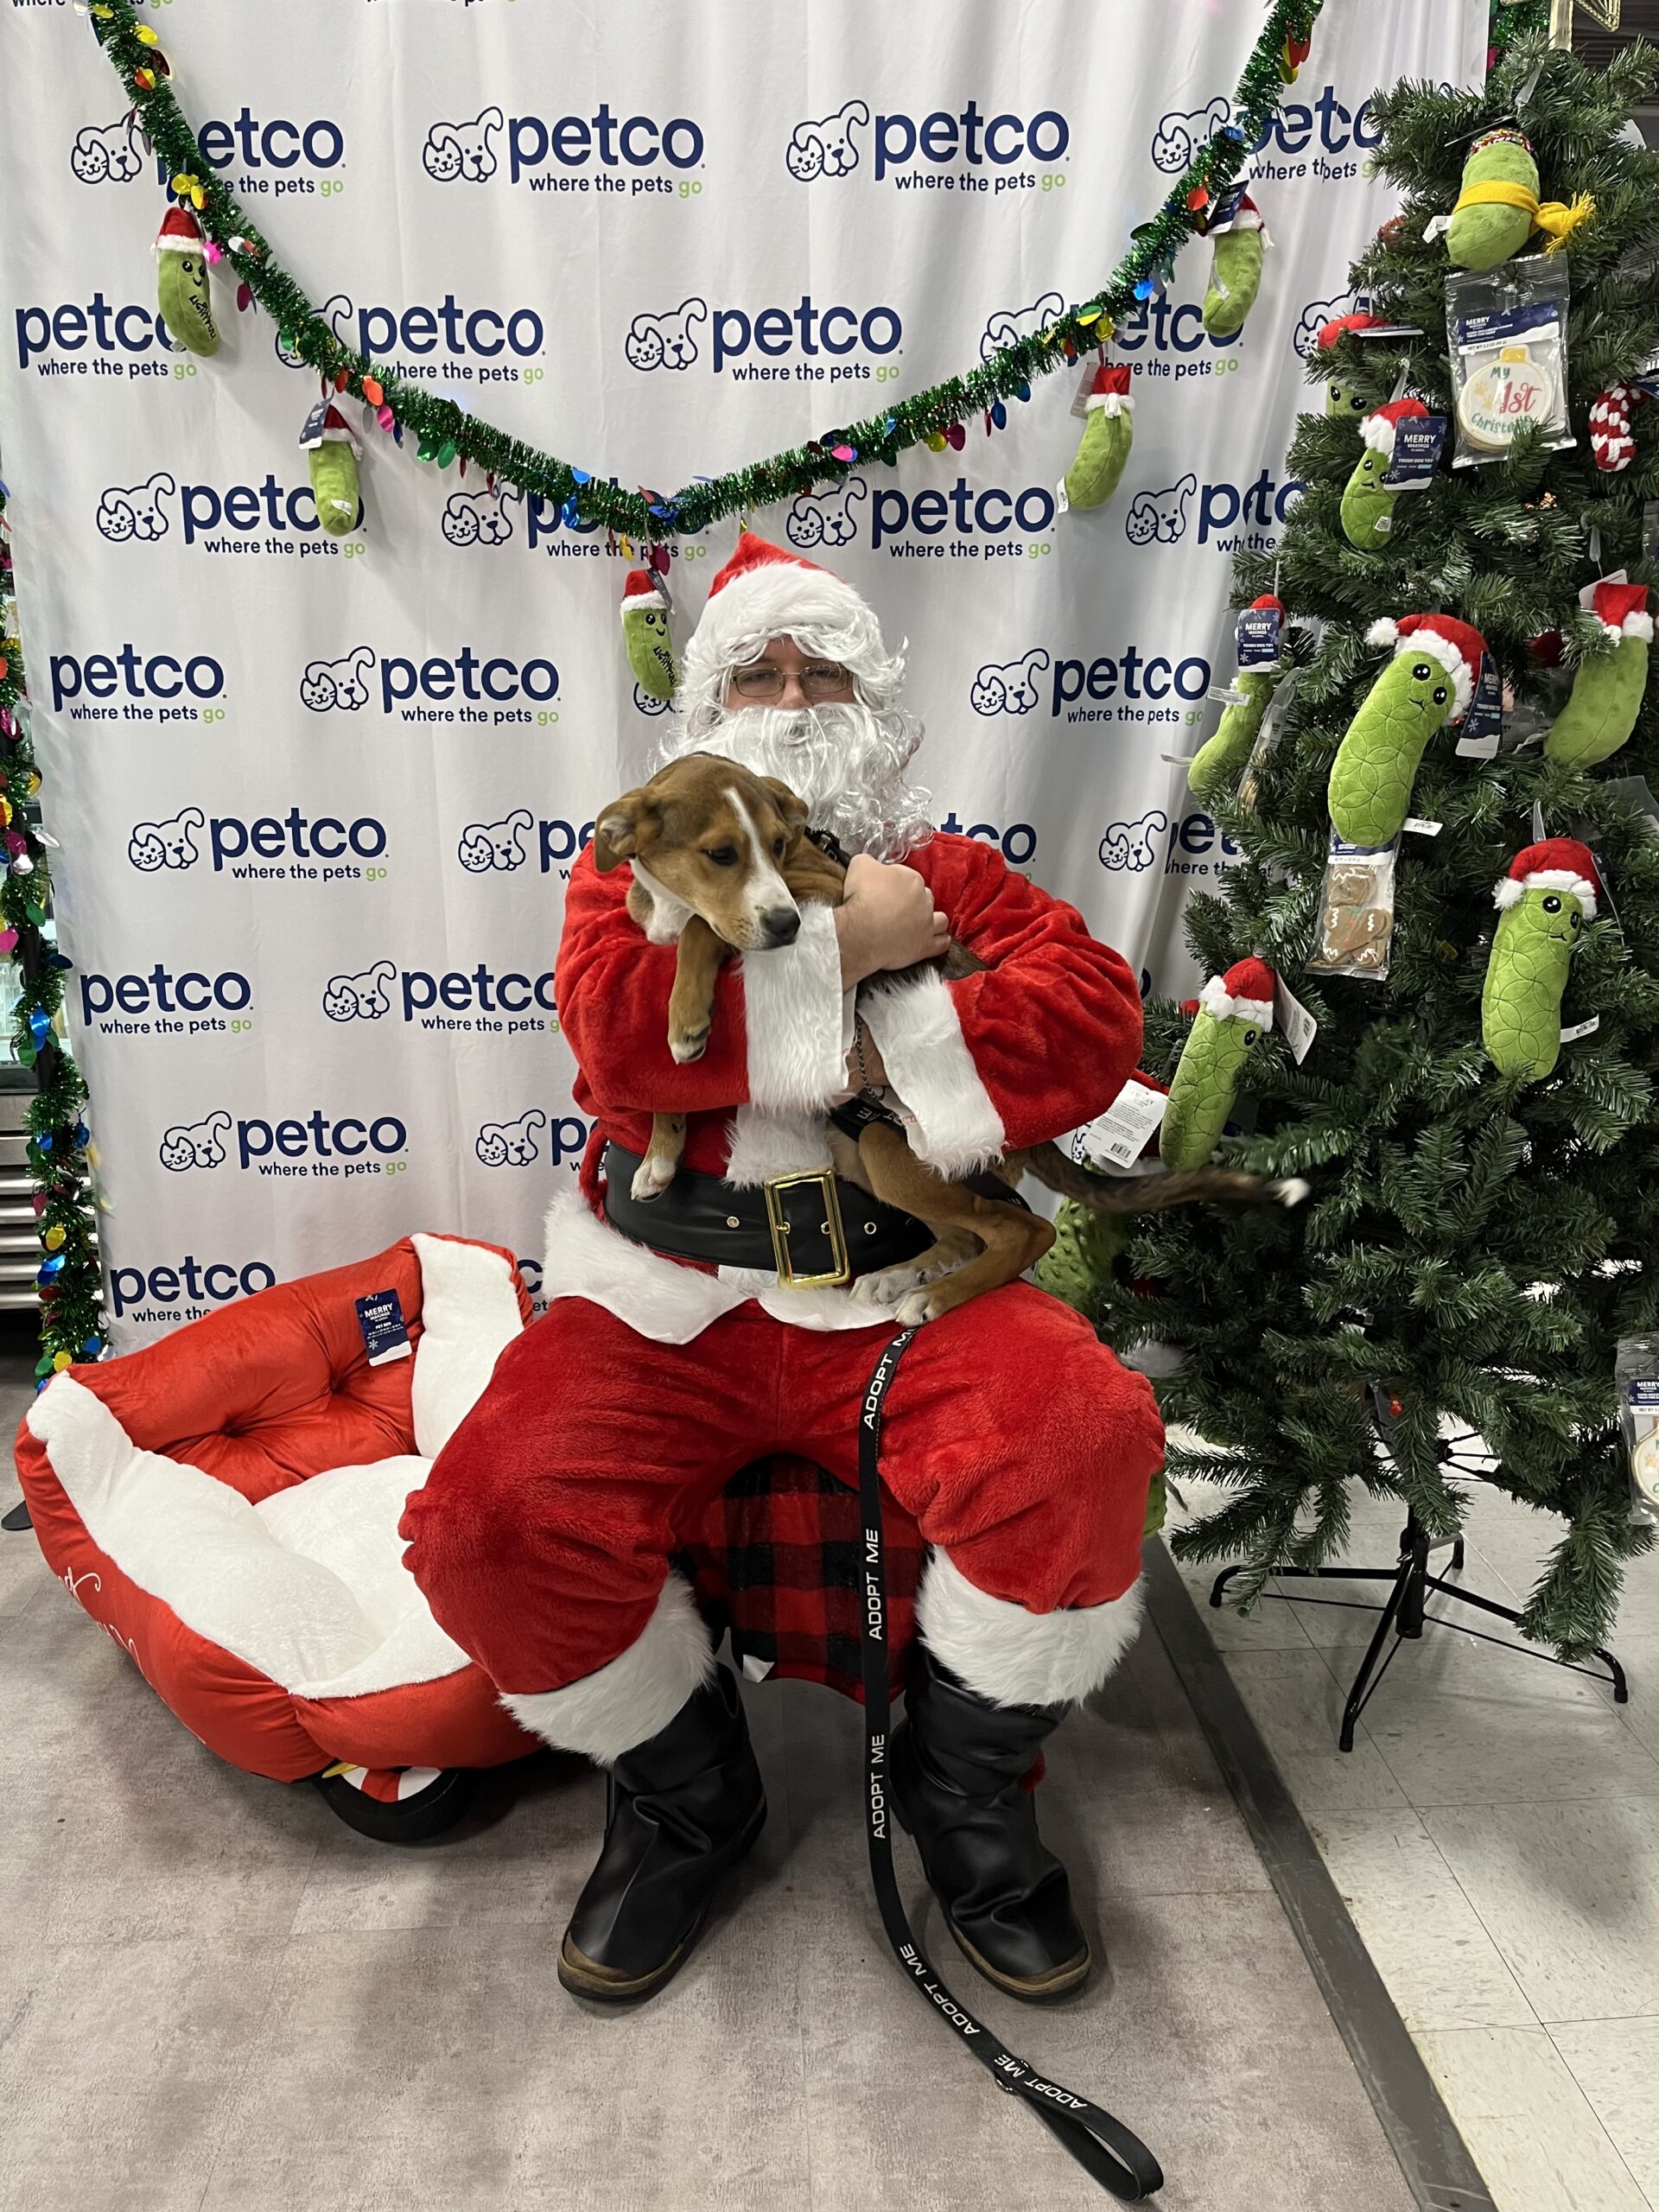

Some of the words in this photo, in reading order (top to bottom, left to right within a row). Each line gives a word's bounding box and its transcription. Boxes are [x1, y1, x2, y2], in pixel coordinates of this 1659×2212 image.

[158, 107, 344, 185] etco
[509, 104, 703, 183] petco
[875, 100, 1069, 181] petco
[895, 170, 954, 189] where
[959, 172, 988, 191] the
[995, 172, 1035, 194] pets
[1043, 175, 1065, 190] go
[1249, 161, 1306, 180] where
[238, 175, 269, 193] the
[275, 177, 315, 197] pets
[321, 181, 343, 196] go
[530, 173, 589, 191] where
[594, 174, 626, 192] the
[632, 176, 672, 196] pets
[679, 181, 701, 199] go
[713, 296, 901, 372] petco
[38, 358, 87, 376] where
[92, 358, 123, 375] the
[129, 360, 168, 379] pets
[174, 365, 197, 380] go
[442, 361, 473, 379] the
[480, 365, 518, 384] pets
[523, 366, 545, 385] go
[733, 363, 790, 380] where
[795, 363, 824, 380] the
[831, 363, 870, 383] pets
[877, 366, 899, 382] go
[1147, 358, 1170, 376] the
[1175, 360, 1211, 381] pets
[1217, 359, 1238, 374] go
[1403, 434, 1436, 443] MERRY
[872, 478, 1054, 550] petco
[204, 537, 260, 553] where
[265, 537, 294, 554] the
[300, 540, 338, 557] pets
[344, 543, 365, 558] go
[547, 540, 600, 556] where
[685, 546, 706, 562] go
[890, 541, 944, 557] where
[950, 541, 978, 556] the
[985, 542, 1022, 560] pets
[1029, 544, 1051, 558] go
[1245, 622, 1273, 631] MERRY
[50, 644, 224, 712] petco
[381, 647, 559, 713] petco
[1052, 646, 1211, 716] petco
[70, 703, 118, 719] where
[123, 704, 153, 719] the
[159, 706, 198, 723] pets
[203, 709, 225, 724] go
[402, 706, 454, 721] where
[459, 707, 487, 721] the
[494, 709, 531, 726] pets
[537, 712, 558, 726] go
[1068, 707, 1112, 723] where
[1117, 705, 1144, 721] the
[1147, 708, 1179, 725] pets
[210, 808, 386, 871] petco
[232, 863, 285, 879] where
[289, 864, 317, 879] the
[323, 865, 360, 882] pets
[366, 868, 387, 881] go
[79, 964, 251, 1026] petco
[100, 1020, 149, 1033] where
[155, 1019, 183, 1033] the
[189, 1018, 226, 1034] pets
[231, 1020, 251, 1033] go
[422, 1015, 471, 1030] where
[475, 1017, 502, 1031] the
[508, 1018, 544, 1034] pets
[550, 1020, 560, 1033] g
[238, 1110, 406, 1169] petco
[258, 1161, 308, 1176] where
[312, 1162, 339, 1176] the
[345, 1161, 380, 1178] pets
[386, 1161, 406, 1175] go
[132, 1308, 181, 1322] where
[364, 1302, 393, 1319] MERRY
[864, 1353, 894, 1430] ADOPT
[866, 1528, 879, 1564] ME
[866, 1571, 883, 1641] ADOPT
[871, 1733, 886, 1764] ME
[870, 1770, 887, 1840] ADOPT
[899, 1942, 926, 1976] ME
[924, 1981, 980, 2036] ADOPT
[994, 2053, 1026, 2078] ME
[1025, 2079, 1087, 2110] ADOPT
